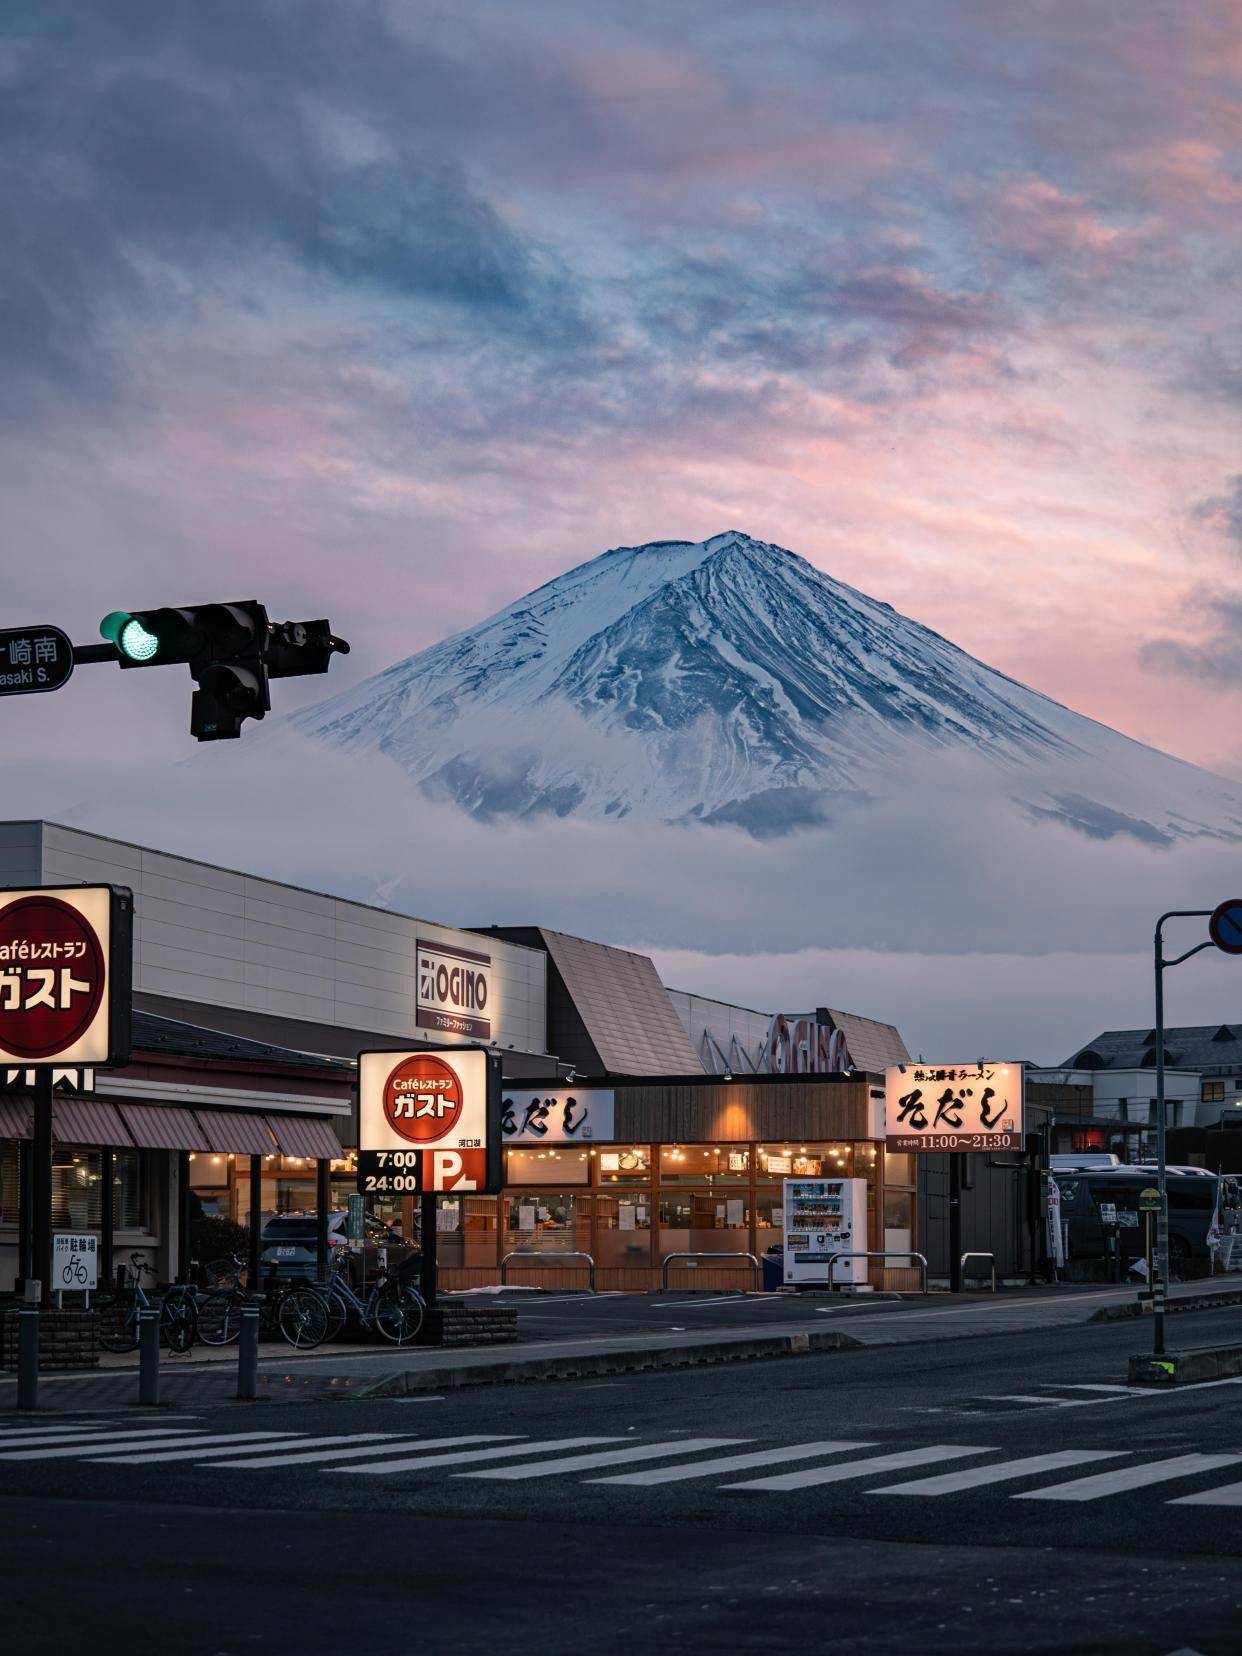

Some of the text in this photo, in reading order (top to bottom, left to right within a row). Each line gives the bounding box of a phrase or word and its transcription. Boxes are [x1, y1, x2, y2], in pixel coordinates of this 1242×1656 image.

[0, 636, 57, 665] 崎南
[36, 667, 50, 683] S.
[436, 963, 488, 1011] OGINO
[394, 1093, 456, 1118] ガスト
[458, 1139, 481, 1148] 河口湖
[376, 1151, 416, 1168] 7:00
[433, 1151, 463, 1191] P
[365, 1175, 416, 1191] 24:00
[70, 1237, 96, 1253] 駐輪場
